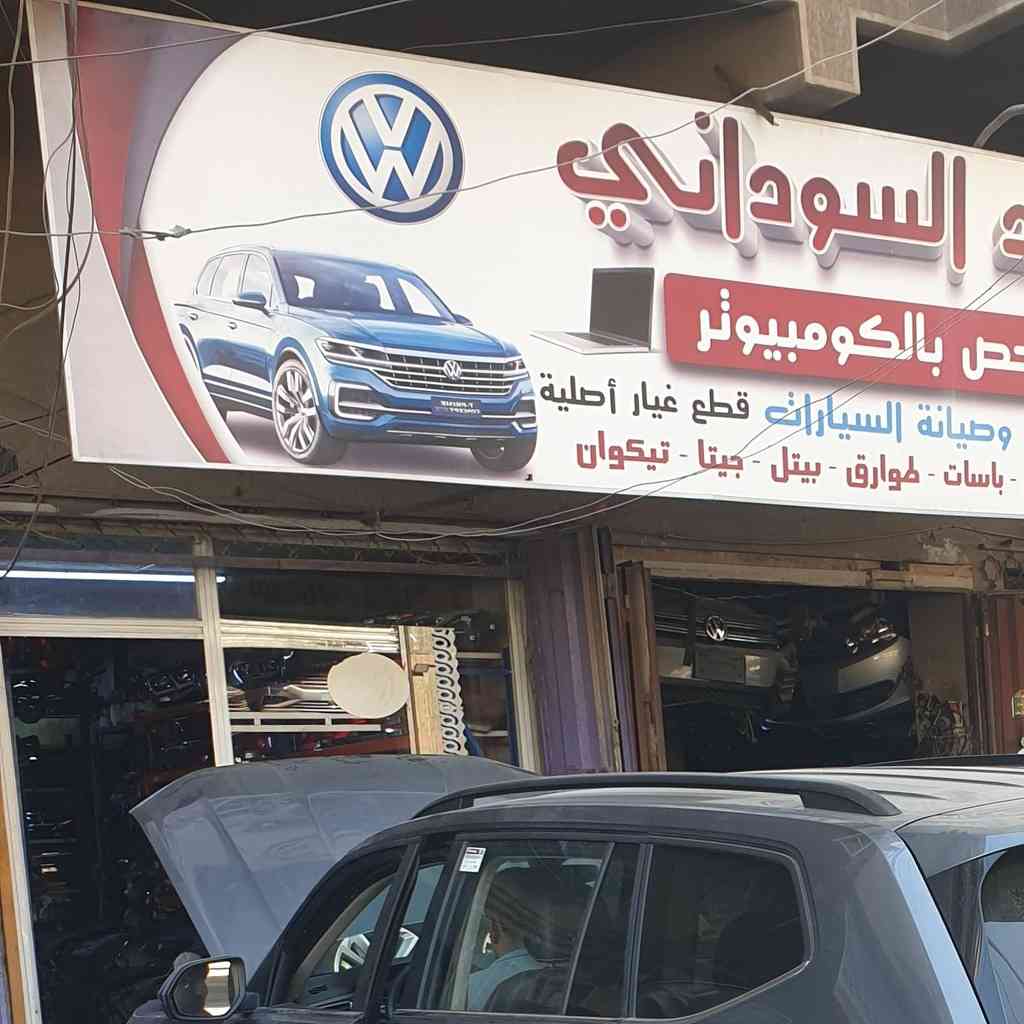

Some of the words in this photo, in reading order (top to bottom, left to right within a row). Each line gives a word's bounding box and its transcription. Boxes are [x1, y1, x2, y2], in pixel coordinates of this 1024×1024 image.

[556, 111, 968, 273] السوداني
[696, 287, 944, 380] بالكومبيوتر
[540, 372, 617, 415] أصلية
[632, 381, 678, 419] غيار
[692, 388, 750, 424] قطع
[765, 391, 902, 443] السيارات
[917, 403, 1013, 450] وصيانة
[576, 430, 670, 473] تيكوان
[697, 438, 744, 480] جيتا
[770, 446, 822, 484] بيتل
[846, 453, 920, 491] طوارق
[943, 459, 1004, 495] باسات
